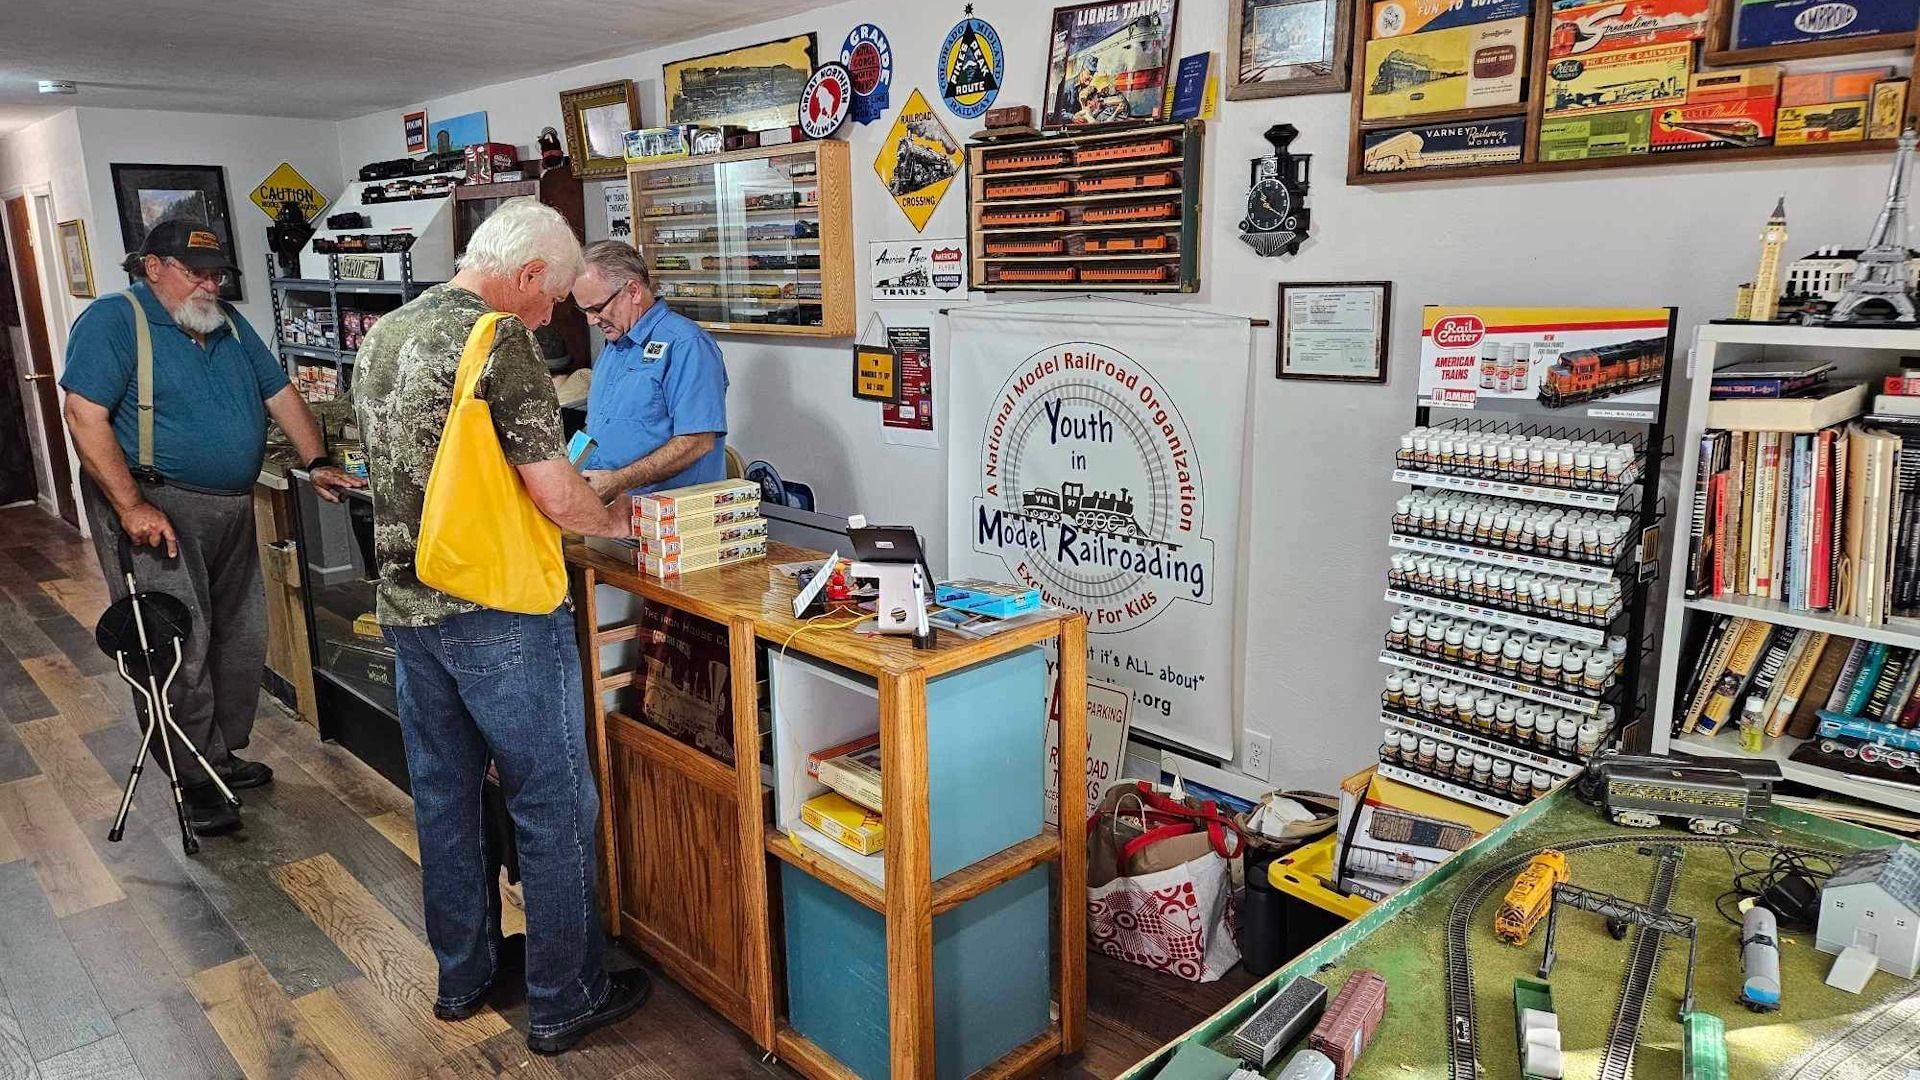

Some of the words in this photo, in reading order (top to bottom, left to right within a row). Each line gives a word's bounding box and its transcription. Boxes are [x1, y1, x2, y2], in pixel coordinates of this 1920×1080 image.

[1078, 5, 1119, 26] LIONEL
[1123, 1, 1169, 18] TRAINS
[849, 25, 890, 86] GRANDE
[940, 25, 964, 89] COLORADO
[951, 43, 968, 84] PIKES
[970, 41, 989, 77] PEAK
[802, 77, 818, 113] GREAT
[820, 68, 849, 103] NORTHERN
[956, 81, 985, 94] ROUTE
[950, 97, 990, 116] RAILWAY
[805, 116, 839, 136] RAILWAY
[900, 111, 932, 125] RAILROAD
[1425, 127, 1470, 139] VARNEY
[260, 186, 313, 203] CAUTION
[902, 196, 935, 207] CROSSING
[875, 248, 906, 266] American
[908, 247, 928, 264] Flyer
[1438, 330, 1478, 343] Center
[1445, 320, 1478, 334] Rail
[1064, 352, 1139, 391] Railroad
[1435, 356, 1476, 367] AMERICAN
[1013, 355, 1059, 398] Model
[1441, 370, 1469, 380] TRAINS
[1446, 391, 1476, 402] AMMO
[1045, 398, 1113, 445] Youth
[986, 394, 1016, 477] National
[1071, 450, 1087, 471] in
[1139, 386, 1196, 532] Organization
[987, 484, 998, 496] A
[1035, 495, 1053, 505] YMR
[1067, 499, 1076, 507] 97
[979, 505, 1047, 551] Model
[1058, 523, 1204, 598] Railroading
[1098, 608, 1123, 625] For
[1128, 590, 1157, 620] Kids
[1100, 650, 1120, 668] it's
[1126, 655, 1154, 676] ALL
[1755, 647, 1788, 688] WORLD
